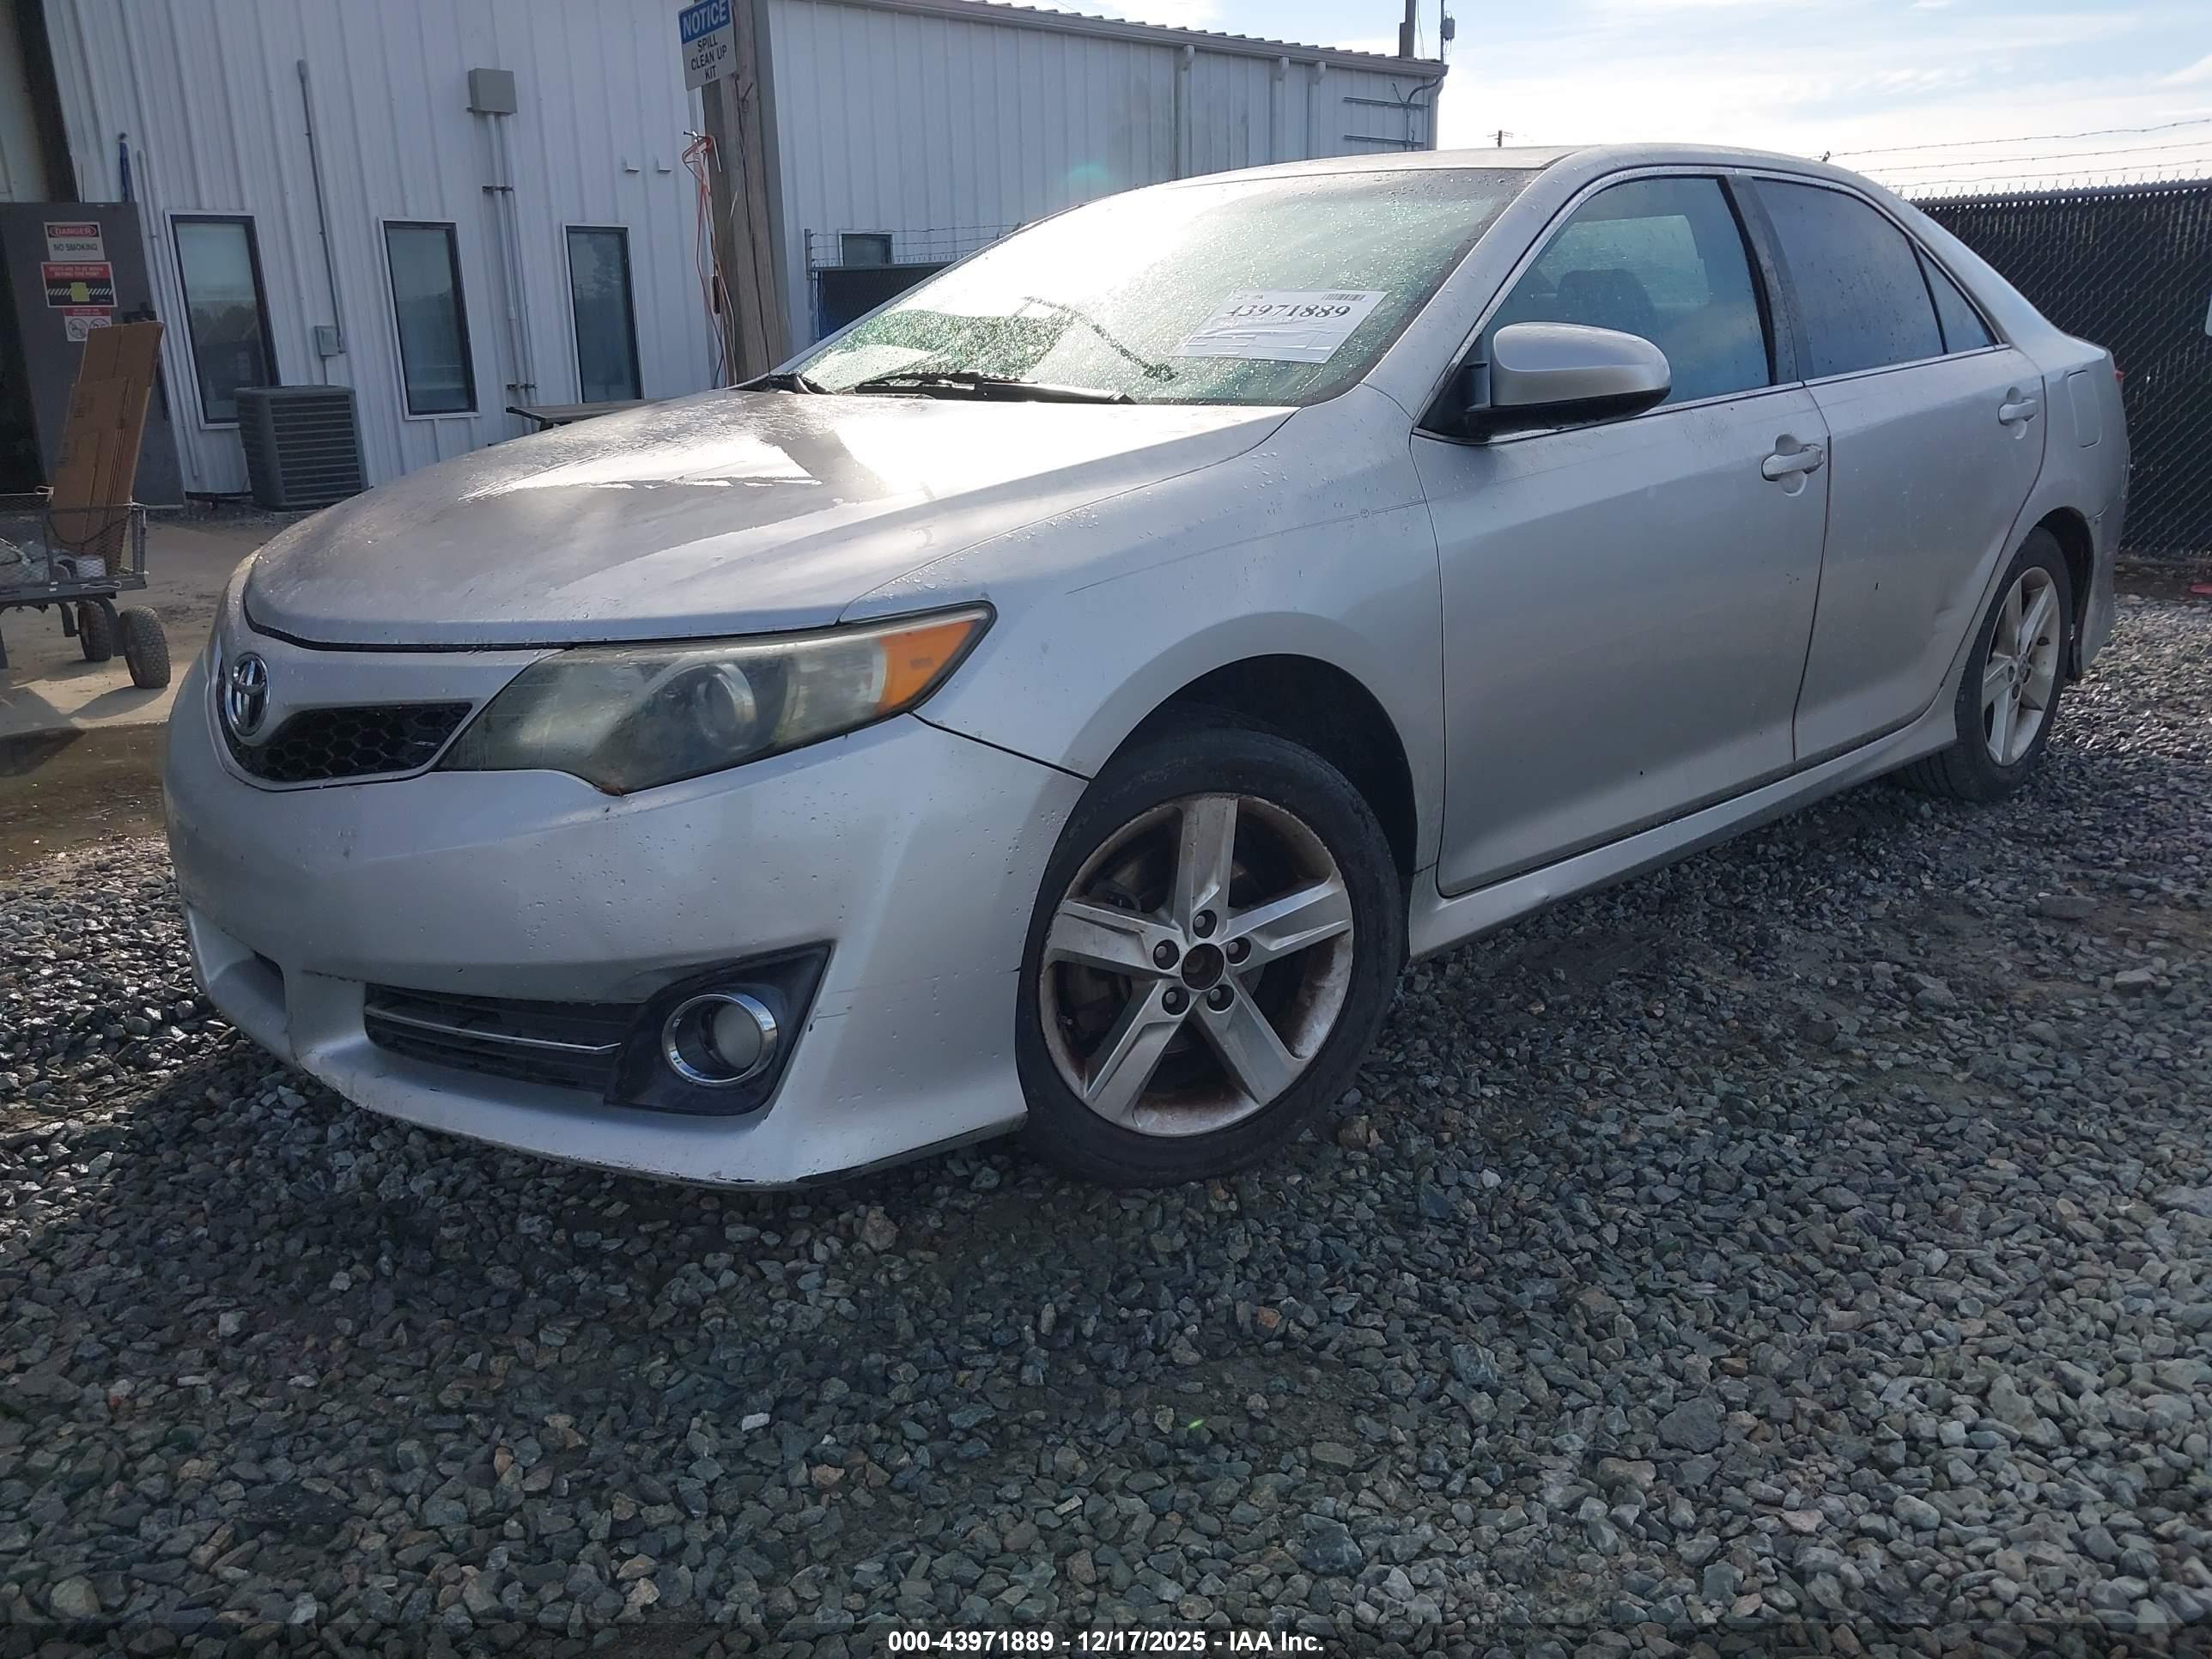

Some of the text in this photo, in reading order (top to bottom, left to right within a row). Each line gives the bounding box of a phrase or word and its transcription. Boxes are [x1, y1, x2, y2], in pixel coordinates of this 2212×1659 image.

[683, 0, 727, 39] NOTICE
[697, 34, 718, 52] SPILL
[691, 45, 727, 70] CLEAN UP
[705, 65, 716, 81] KIT
[53, 243, 98, 252] NO SMOKING
[1226, 304, 1351, 318] 43971889
